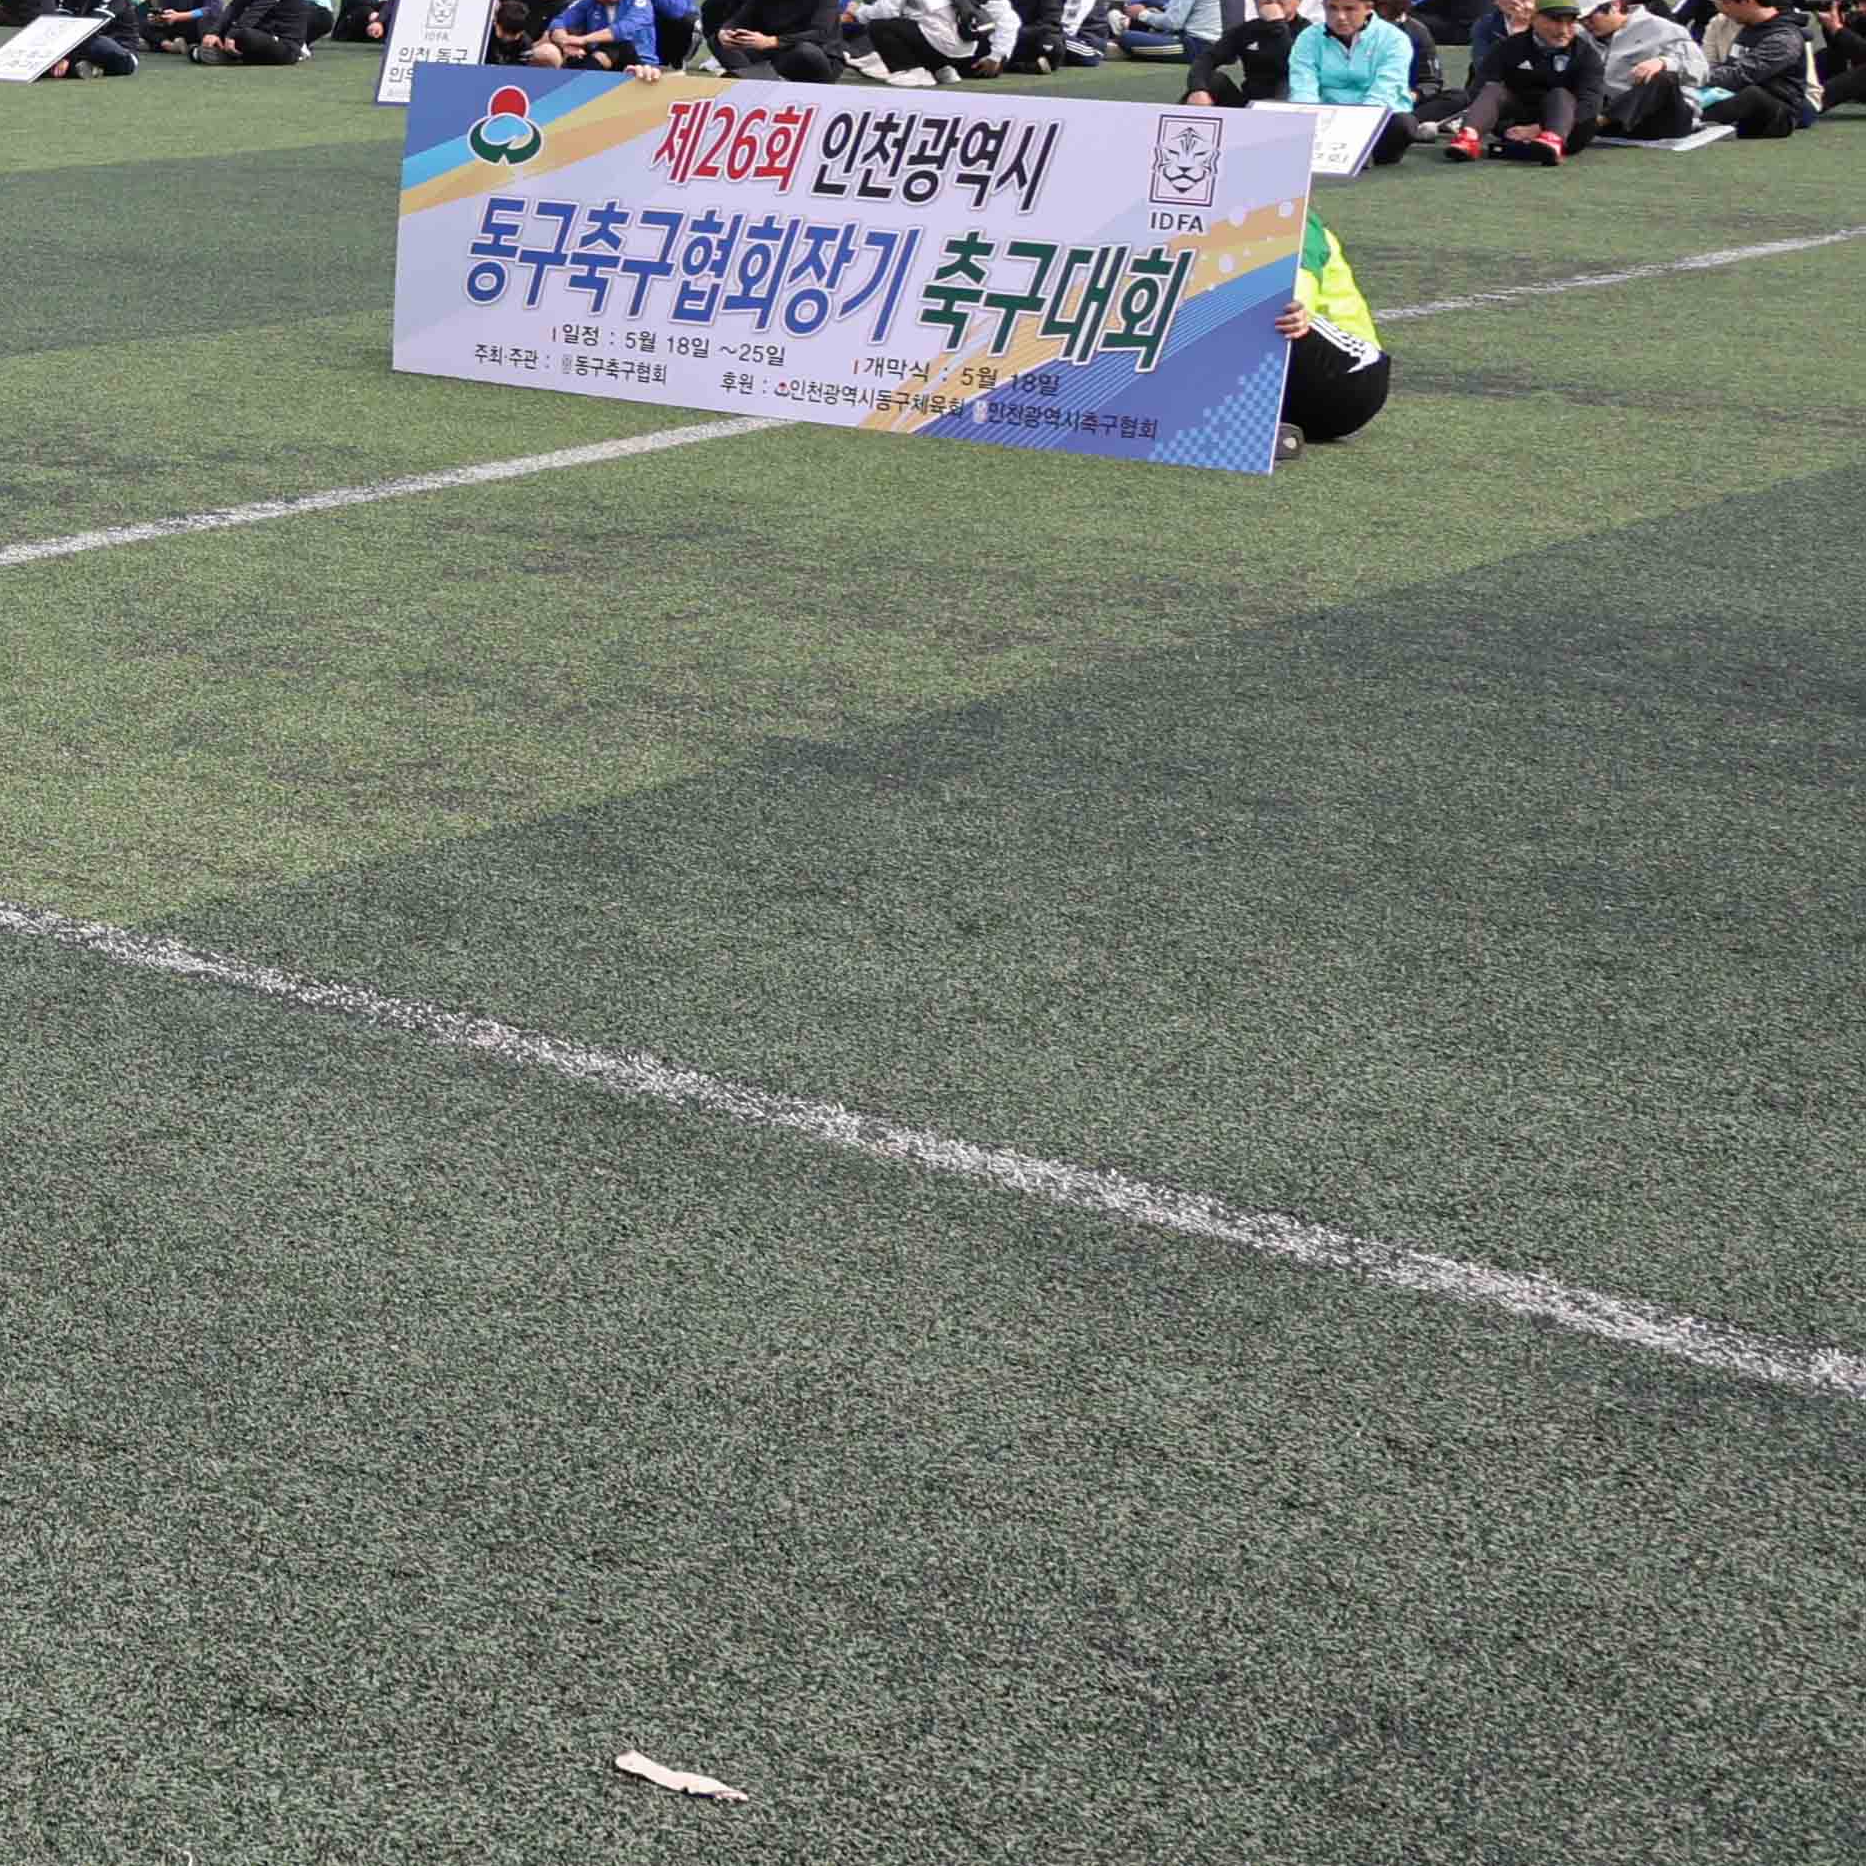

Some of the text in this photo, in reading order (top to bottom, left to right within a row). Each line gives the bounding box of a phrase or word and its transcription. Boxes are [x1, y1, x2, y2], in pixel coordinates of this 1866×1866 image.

[652, 100, 1061, 214] 제26회 인천광역시
[1149, 211, 1205, 235] IDFA
[467, 196, 1195, 370] 동구축구협회장기 축구대회
[561, 322, 600, 347] 일정
[625, 330, 657, 354] 5월
[667, 336, 710, 359] 18일
[719, 343, 786, 367] ~25일
[574, 356, 667, 387] 동구축구협회
[866, 357, 931, 383] 개막식
[961, 365, 998, 391] 5월
[1010, 371, 1061, 398] 18일
[720, 370, 755, 396] 후원
[789, 378, 965, 420] 인천광역시동구체육회
[987, 399, 1158, 441] 인천광역시축구협회
